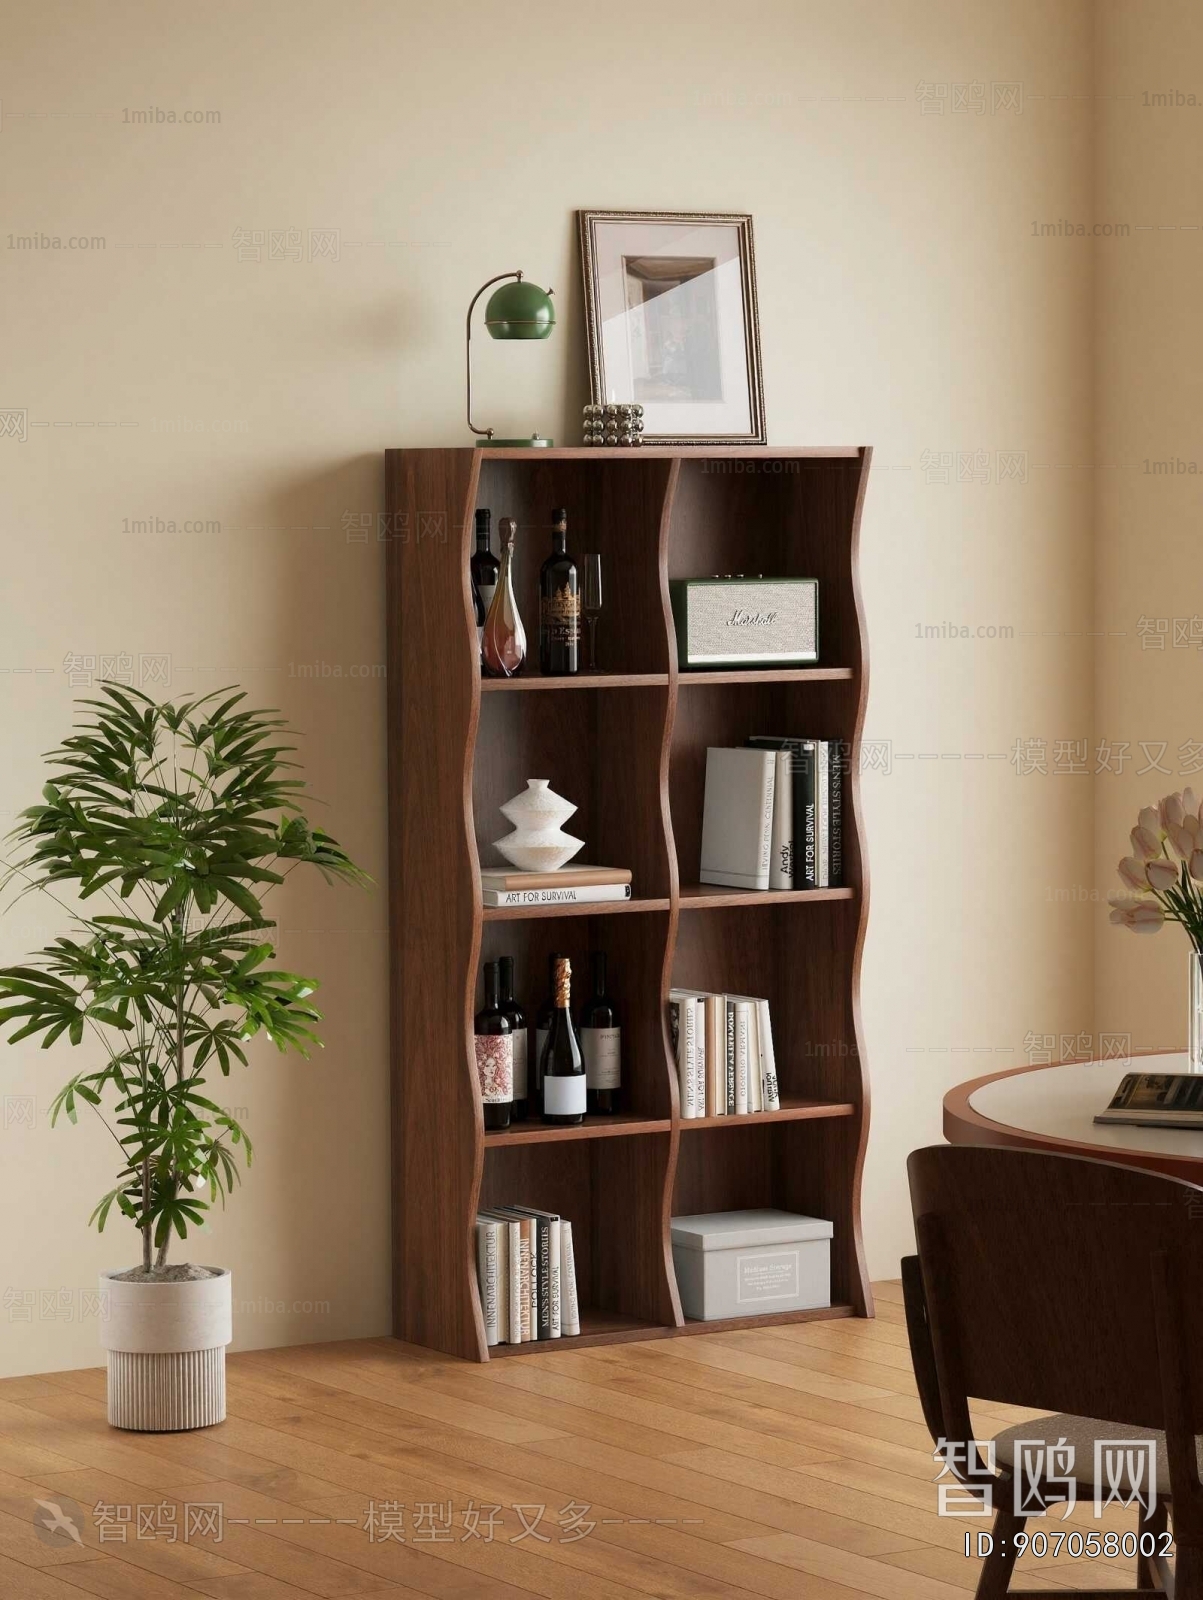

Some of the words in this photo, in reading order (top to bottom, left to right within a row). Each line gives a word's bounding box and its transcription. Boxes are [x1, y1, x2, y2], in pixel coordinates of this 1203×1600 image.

[726, 610, 778, 627] Marshall
[805, 803, 815, 843] SURVIVAL
[832, 790, 842, 827] STYLE
[780, 845, 789, 874] Andy
[805, 844, 815, 863] FOR
[832, 828, 842, 875] STORIES
[805, 866, 815, 881] ART
[505, 892, 521, 904] ART
[523, 891, 540, 903] FOR
[541, 890, 577, 902] SURVIVAL
[540, 1226, 549, 1266] STORIES
[486, 1231, 497, 1328] INNENARCHITEKTUR
[520, 1237, 530, 1336] INNENARCHITEKTUR
[541, 1267, 550, 1297] STYLE
[551, 1265, 560, 1299] SURVIVAL
